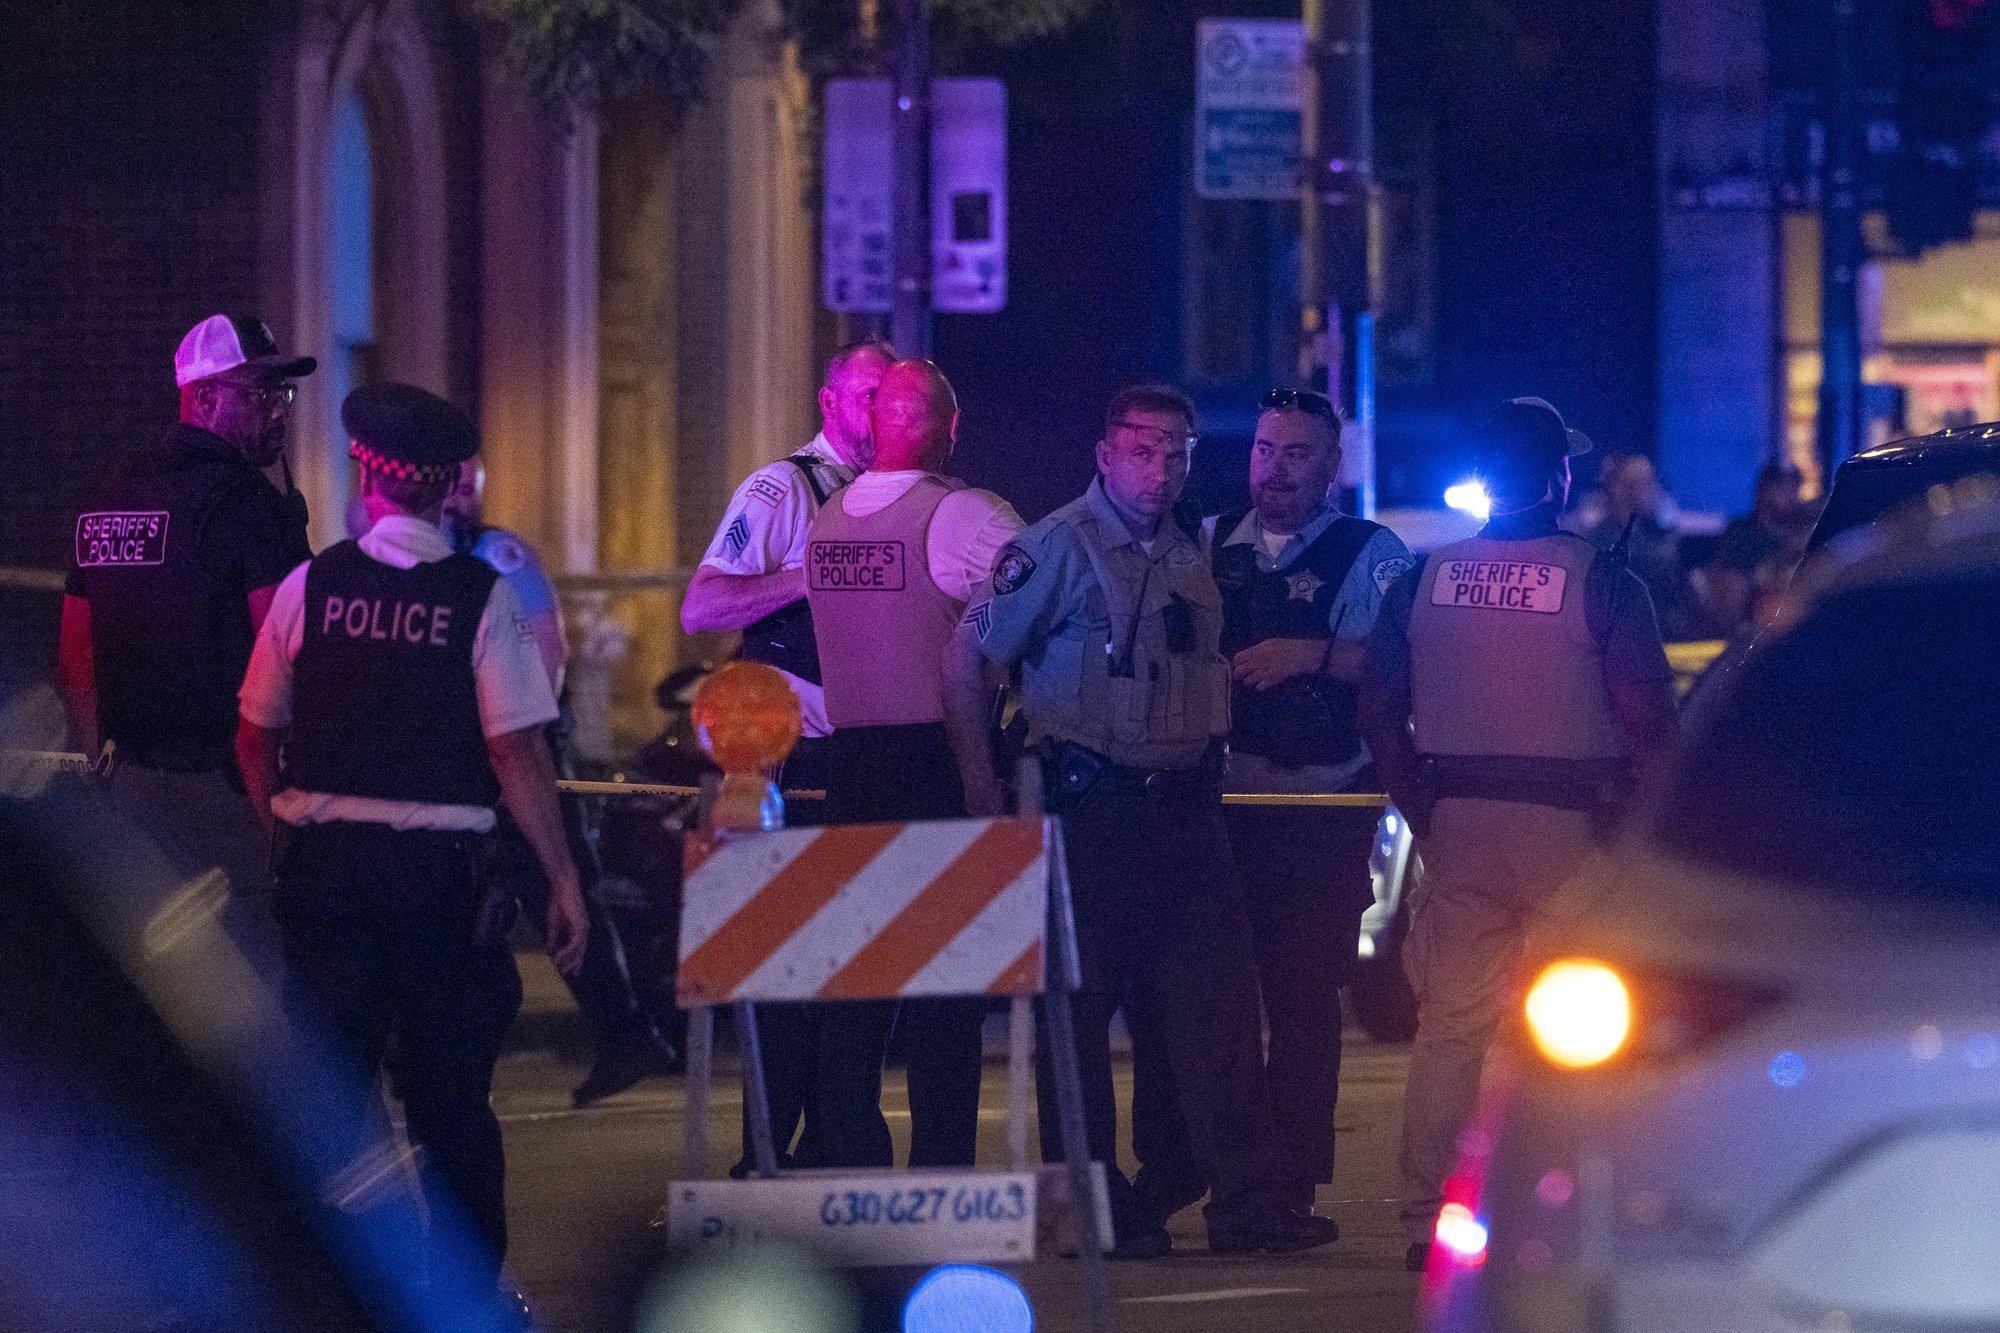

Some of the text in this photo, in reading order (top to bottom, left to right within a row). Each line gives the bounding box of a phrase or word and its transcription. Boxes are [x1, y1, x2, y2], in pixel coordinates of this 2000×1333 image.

[83, 517, 159, 539] SHERIFF'S
[89, 540, 145, 561] POLICE
[814, 544, 895, 565] SHERIFF'S
[820, 566, 884, 586] POLICE
[1449, 562, 1550, 586] SHERIFF'S
[1454, 583, 1535, 608] POLICE
[322, 597, 452, 646] POLICE
